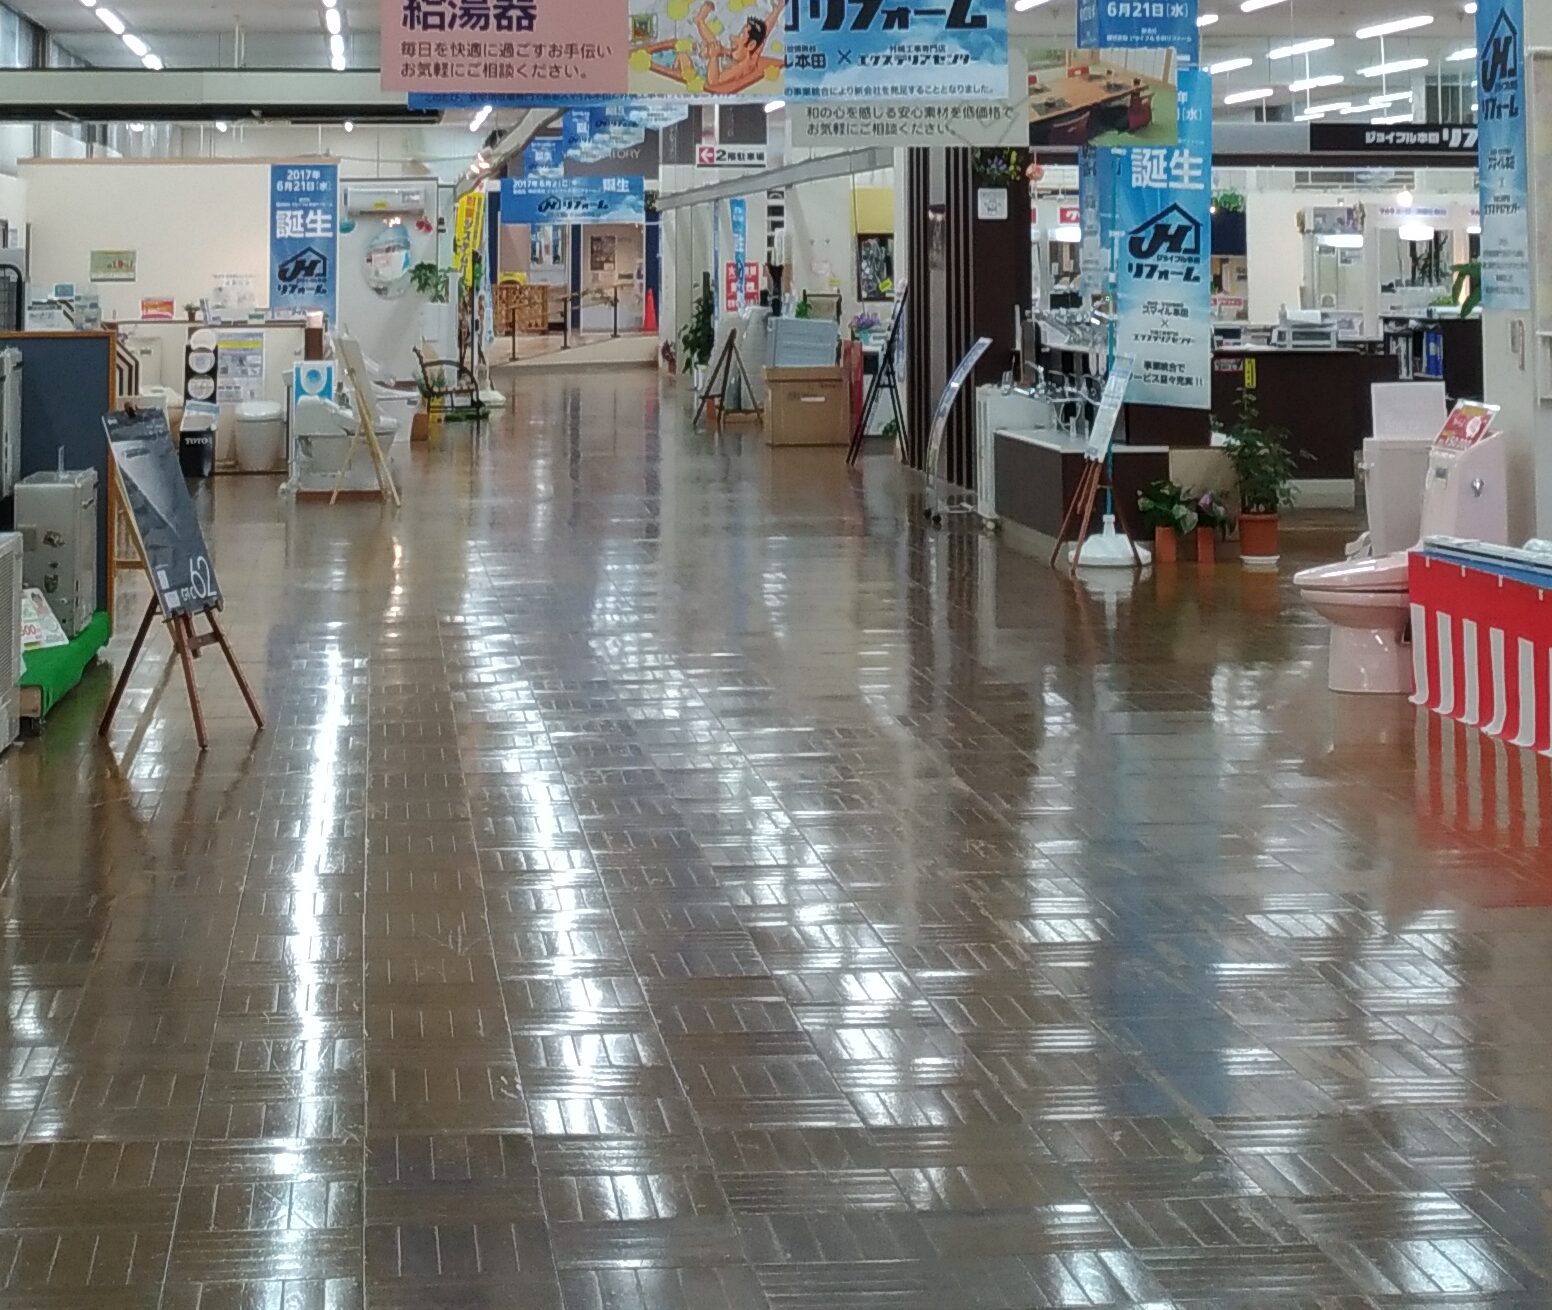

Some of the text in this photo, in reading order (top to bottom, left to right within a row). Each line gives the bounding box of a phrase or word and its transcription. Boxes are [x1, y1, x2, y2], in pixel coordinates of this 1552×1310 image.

[400, 41, 612, 60] 毎日を快適に過ごすお手伝い
[400, 61, 587, 80] お気軽にご相談ください。
[806, 104, 1014, 121] 和の心を感じる安心素材を低価格で
[1480, 94, 1519, 123] リフォーム
[806, 121, 956, 137] お気軽にご相談ください。
[1364, 130, 1440, 145] ジョイフル本田
[715, 149, 765, 162] 2階駐車場
[286, 169, 321, 181] 2017年
[1130, 147, 1205, 190] 誕生
[275, 209, 334, 239] 誕生
[1127, 262, 1201, 283] リフォーム
[277, 284, 328, 296] リフォーム
[1143, 360, 1186, 373] 事業統合で
[184, 437, 209, 445] TOTO
